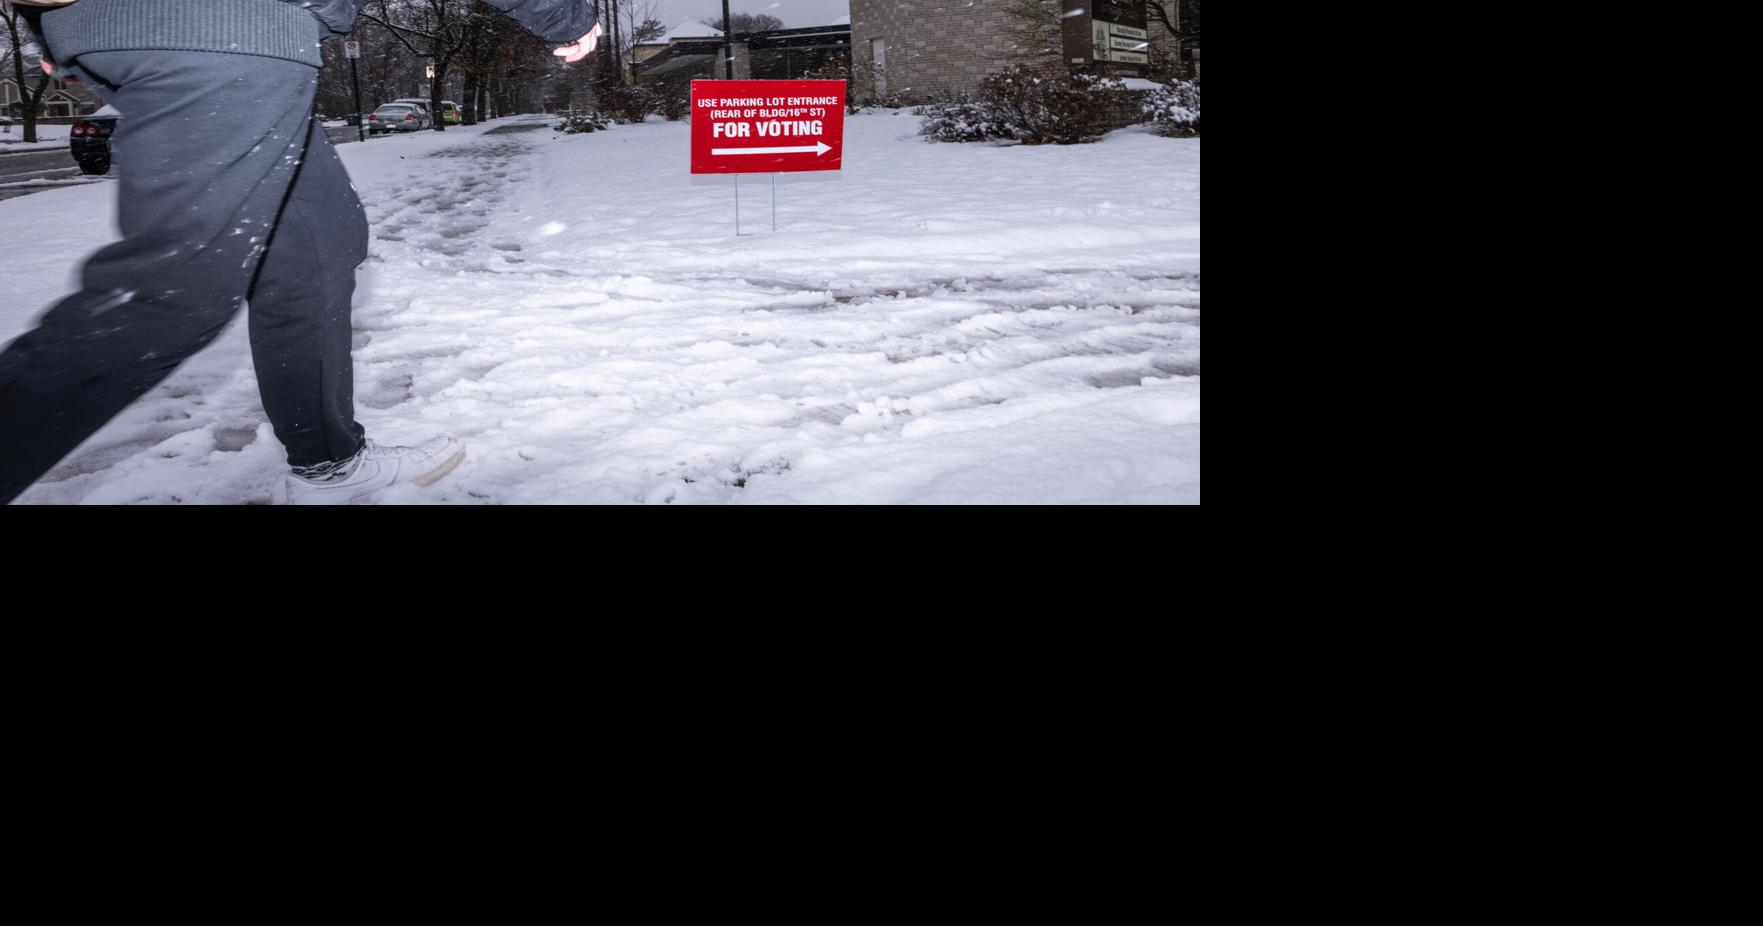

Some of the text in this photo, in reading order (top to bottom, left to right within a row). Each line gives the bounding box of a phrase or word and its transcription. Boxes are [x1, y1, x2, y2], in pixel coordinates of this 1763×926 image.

[698, 96, 838, 108] USE PARKING LOT ENTRANCE
[710, 107, 826, 120] (REAR OF BLDG/16TH ST)
[713, 120, 823, 138] FOR VOTING
